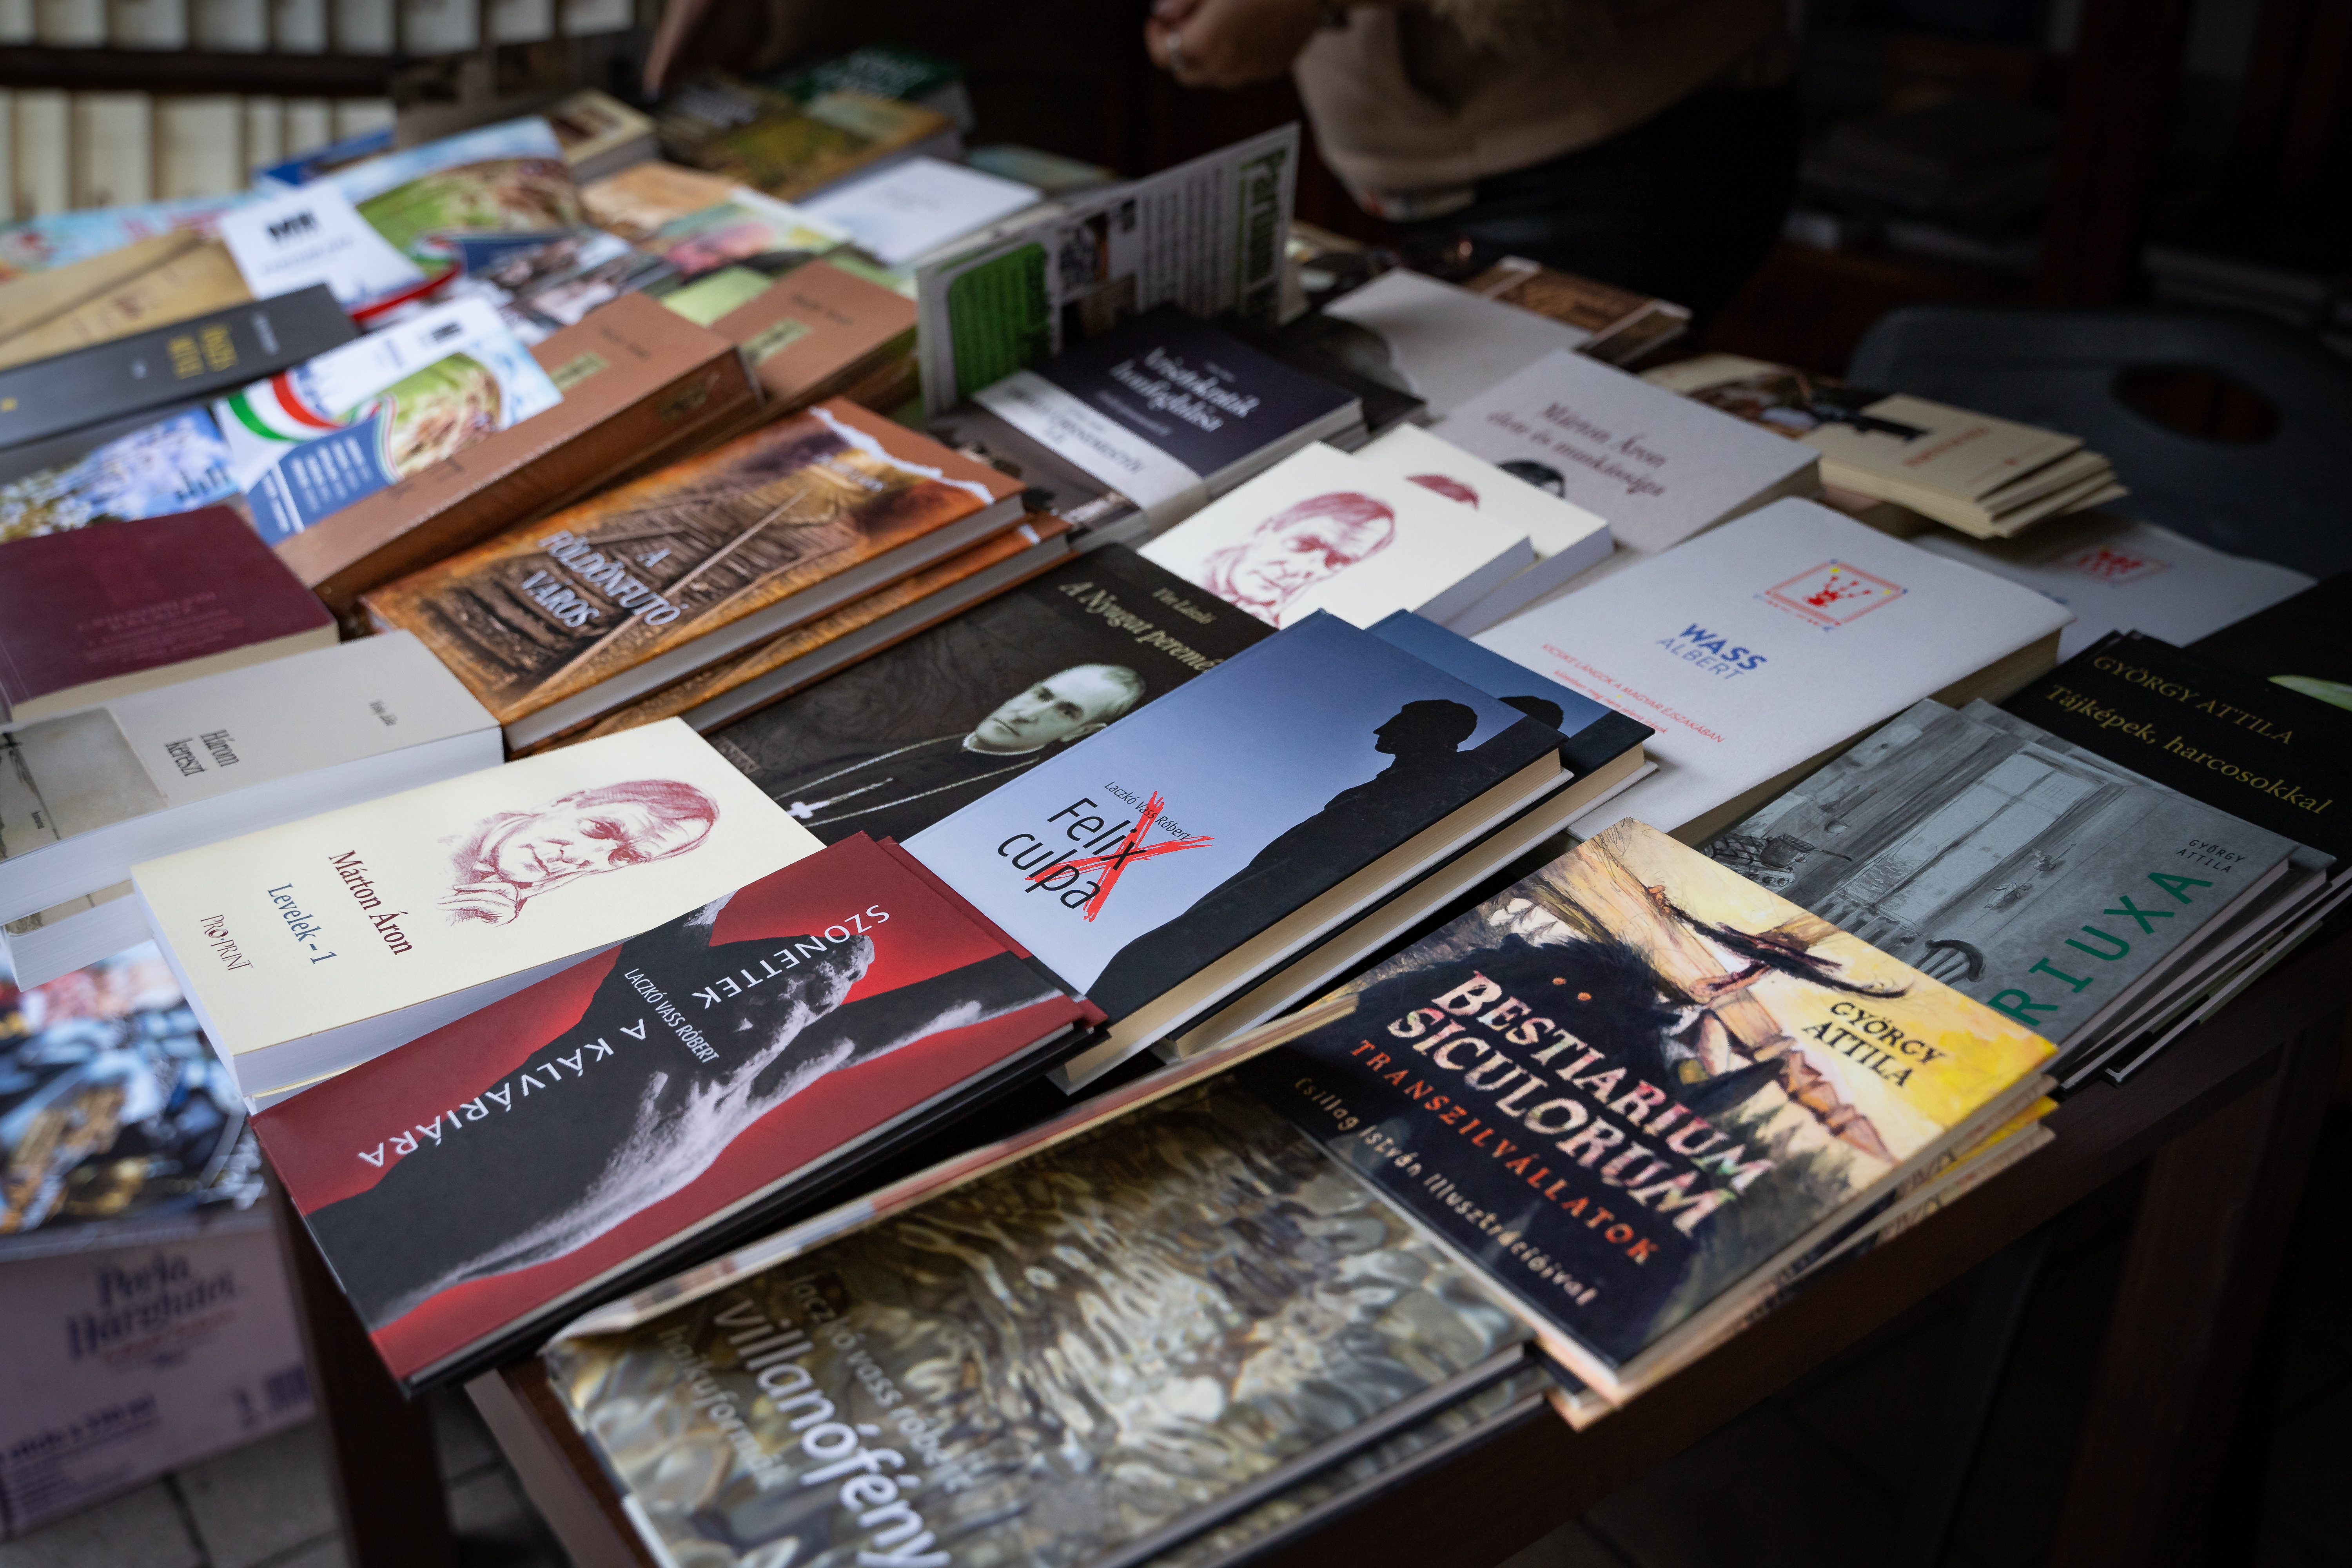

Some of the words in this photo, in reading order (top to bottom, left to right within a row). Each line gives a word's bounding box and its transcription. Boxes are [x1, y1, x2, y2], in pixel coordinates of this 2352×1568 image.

[1539, 401, 1611, 445] Márton
[636, 548, 671, 568] A
[521, 570, 600, 628] VÁROS
[1060, 581, 1094, 597] A
[1078, 589, 1154, 634] Nyugat
[1136, 630, 1224, 673] peremé
[1654, 637, 1744, 680] ALBERT
[1679, 622, 1767, 671] WASS
[1621, 686, 1664, 710] MAGYAR
[1660, 706, 1726, 743] ÉJSZAKÁBAN
[2093, 655, 2200, 704] GYÖRGY
[2195, 699, 2295, 745] ATTILA
[2045, 684, 2156, 744] Tájképek,
[2163, 735, 2334, 815] harcosokkal
[1047, 797, 1147, 871] Felix
[1103, 781, 1138, 805] Laczkó
[1135, 800, 1158, 819] Vass
[1155, 816, 1192, 841] Róbert
[997, 833, 1101, 909] culpa
[2176, 848, 2233, 874] ATTILA
[267, 883, 322, 942] Levelek
[328, 849, 382, 911] Márton
[368, 911, 414, 955] Áron
[691, 904, 890, 1009] SZONETTEK
[619, 1018, 646, 1040] A
[624, 968, 668, 1004] LACZKÓ
[655, 1000, 686, 1027] VASS
[675, 1024, 720, 1063] RÓBERT
[1829, 1001, 1946, 1065] GYÖRGY
[1431, 969, 1777, 1193] BESTIARIUM
[1801, 1021, 1913, 1088] ATTILA
[358, 1037, 614, 1167] KÁLVÁRIÁRA
[1295, 1077, 1360, 1131] Csillag
[1358, 1125, 1422, 1177] István
[1386, 1007, 1738, 1239] SICULORUM
[844, 1349, 903, 1408] vass
[713, 1298, 952, 1567] villanófény
